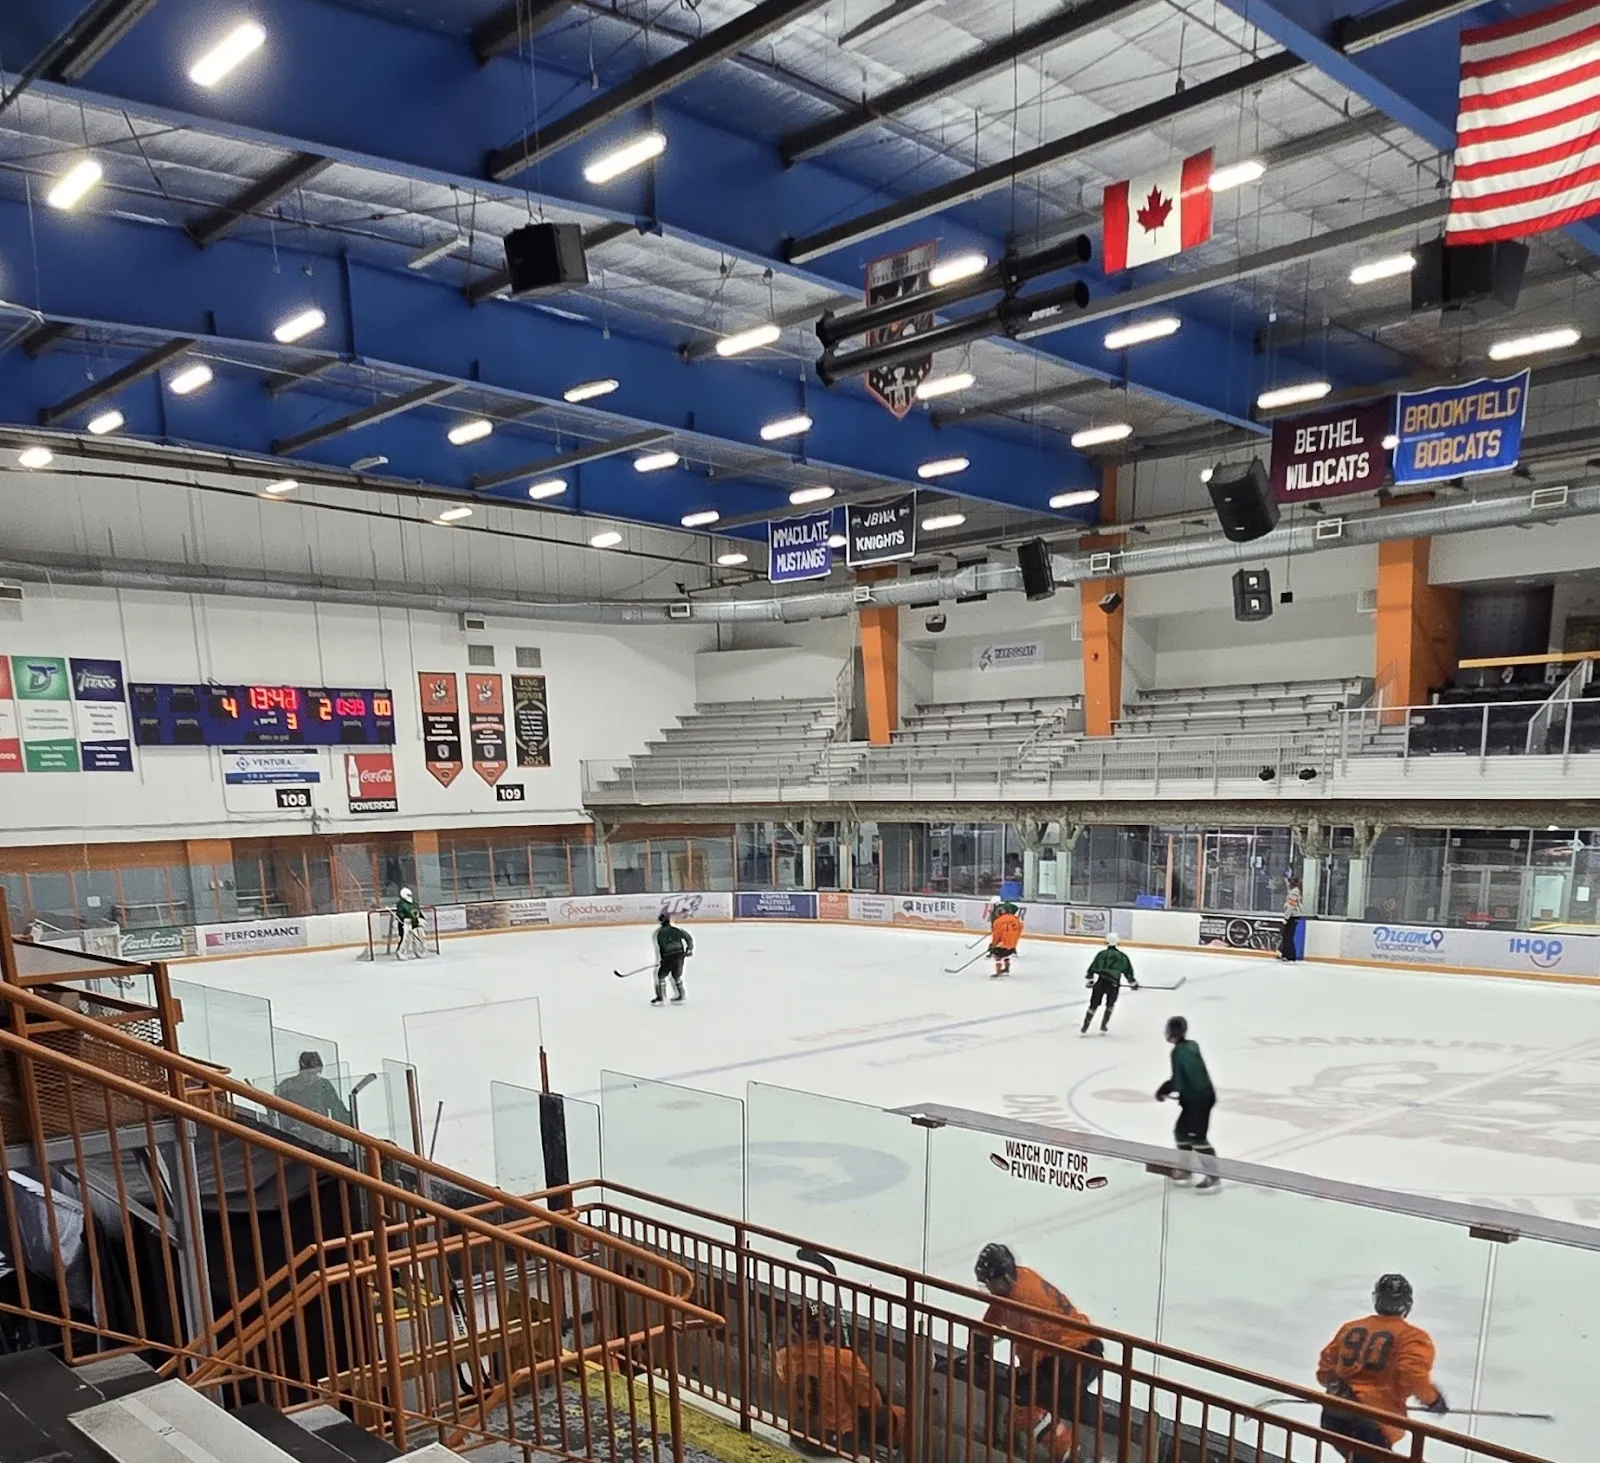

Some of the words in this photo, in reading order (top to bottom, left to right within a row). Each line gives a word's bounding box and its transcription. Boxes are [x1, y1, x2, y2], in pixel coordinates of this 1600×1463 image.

[1404, 387, 1521, 433] BROOKFIELD
[1294, 418, 1364, 454] BETHEL
[1413, 429, 1502, 470] BOBCATS
[1286, 452, 1370, 491] WILDCATS
[855, 529, 905, 552] KNIGHTS
[777, 548, 826, 573] MUSTANGS
[222, 697, 239, 719] 4
[319, 698, 332, 720] 2
[285, 712, 298, 730] 3
[252, 756, 292, 766] VENTURA
[280, 794, 307, 807] 108
[350, 800, 397, 811] POWERADE
[499, 789, 521, 800] 109
[915, 900, 957, 914] REVERIE
[224, 926, 301, 941] PERFORMANCE
[1373, 926, 1431, 945] Dream
[1005, 1140, 1041, 1162] WATCH
[1043, 1148, 1064, 1167] OUT
[1067, 1153, 1088, 1173] FOR
[1011, 1160, 1046, 1183] FLYING
[1048, 1169, 1084, 1191] PUCKS
[1342, 1326, 1395, 1371] 90
